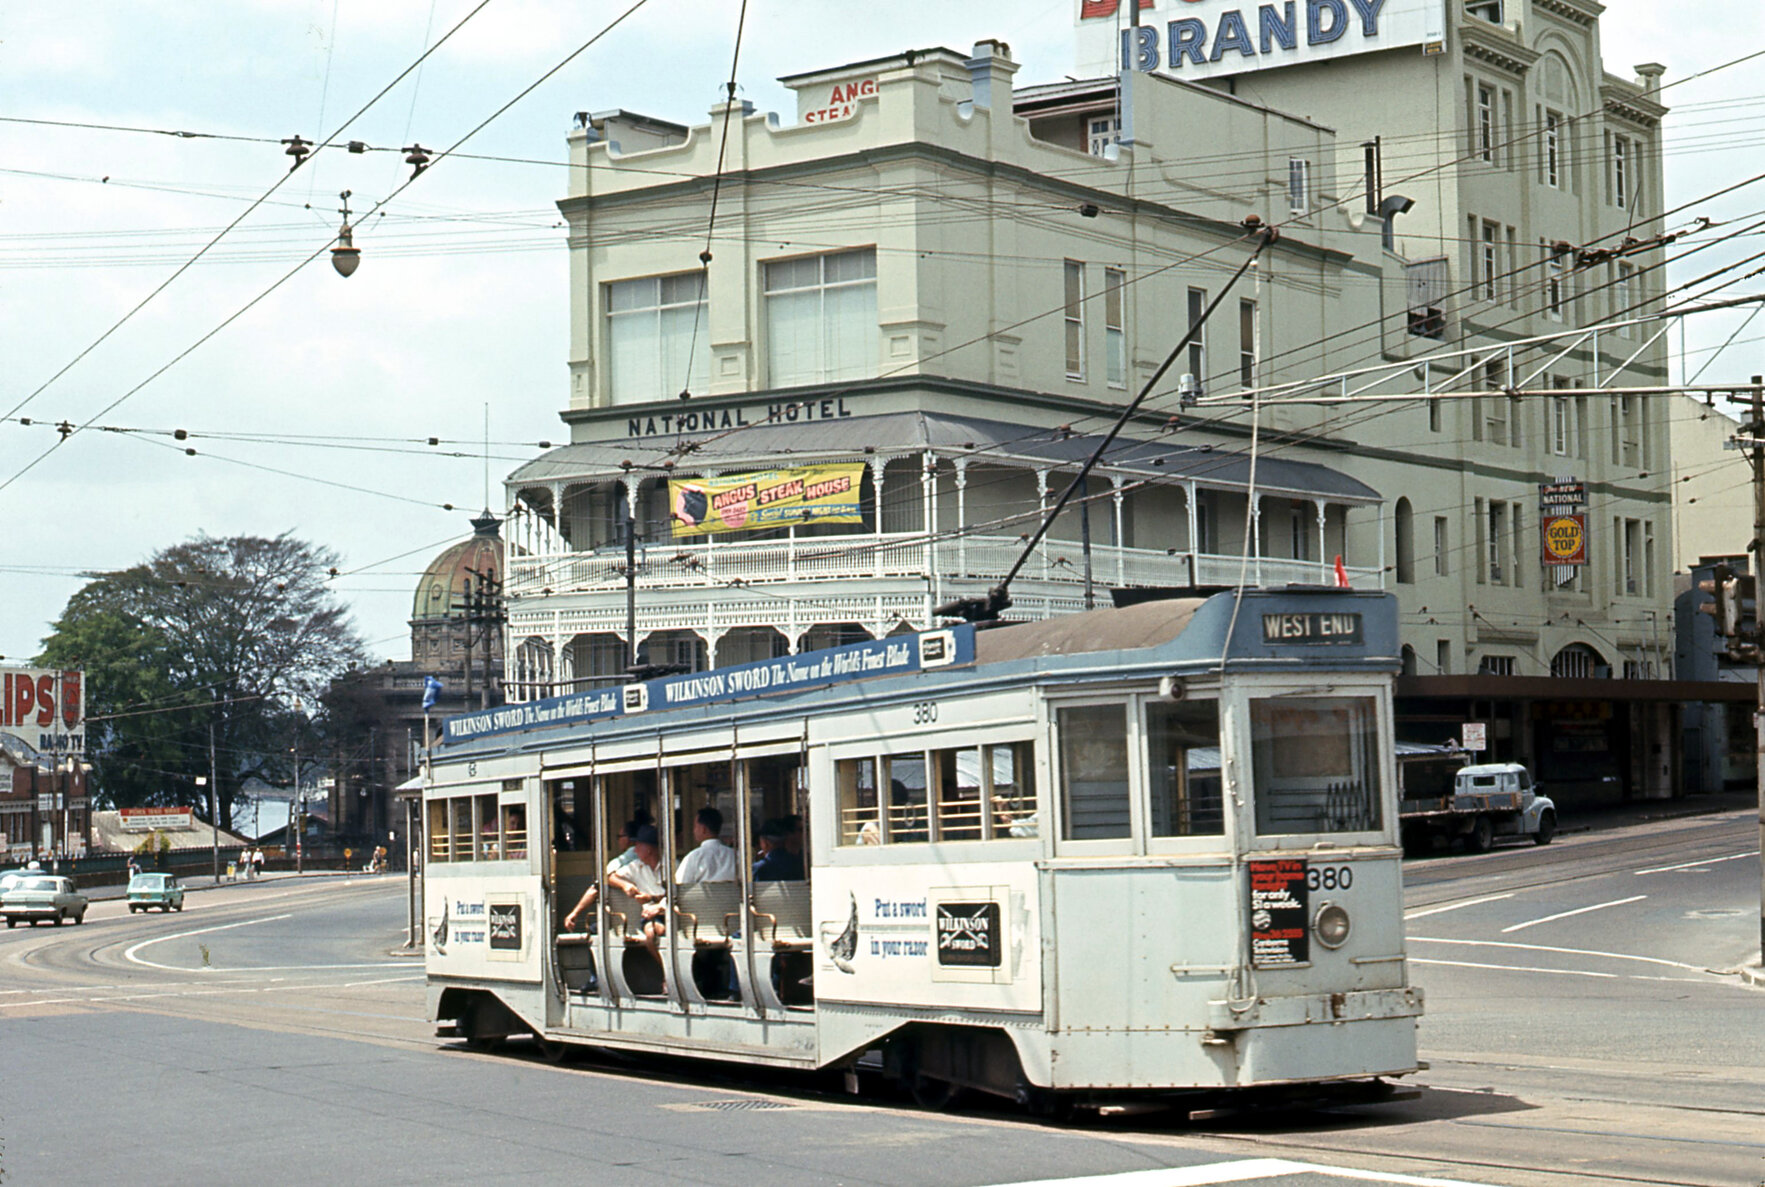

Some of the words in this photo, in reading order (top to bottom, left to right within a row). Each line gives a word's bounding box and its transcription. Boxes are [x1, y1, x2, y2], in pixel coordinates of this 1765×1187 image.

[1120, 0, 1384, 73] BRANDY
[805, 104, 856, 123] STEA
[628, 408, 749, 437] NATIONAL
[768, 398, 851, 424] HOTEL
[712, 485, 756, 510] ANGUS
[759, 480, 804, 505] STEAK
[805, 476, 849, 500] HOUSE
[1543, 493, 1583, 504] NATIONAL
[1550, 527, 1578, 538] GOLD
[1553, 539, 1576, 551] TOP
[1265, 615, 1311, 638] WEST
[1320, 614, 1354, 636] END
[665, 675, 726, 703] WILKINSON
[728, 666, 770, 693] SWORD
[771, 664, 786, 685] The
[786, 661, 809, 683] Name
[821, 656, 833, 676] the
[886, 643, 910, 667] Blade
[0, 673, 55, 727] IPS
[450, 715, 493, 737] WILKINSON
[493, 707, 523, 730] SWORD
[913, 702, 938, 725] 380
[1308, 867, 1352, 891] 380
[1252, 890, 1267, 900] for
[1268, 888, 1291, 901] only
[875, 898, 890, 917] Put
[892, 903, 898, 917] a
[900, 897, 926, 917] sword
[938, 917, 989, 931] WILKINSON
[871, 937, 880, 954] in
[882, 940, 901, 958] your
[904, 940, 928, 955] razor
